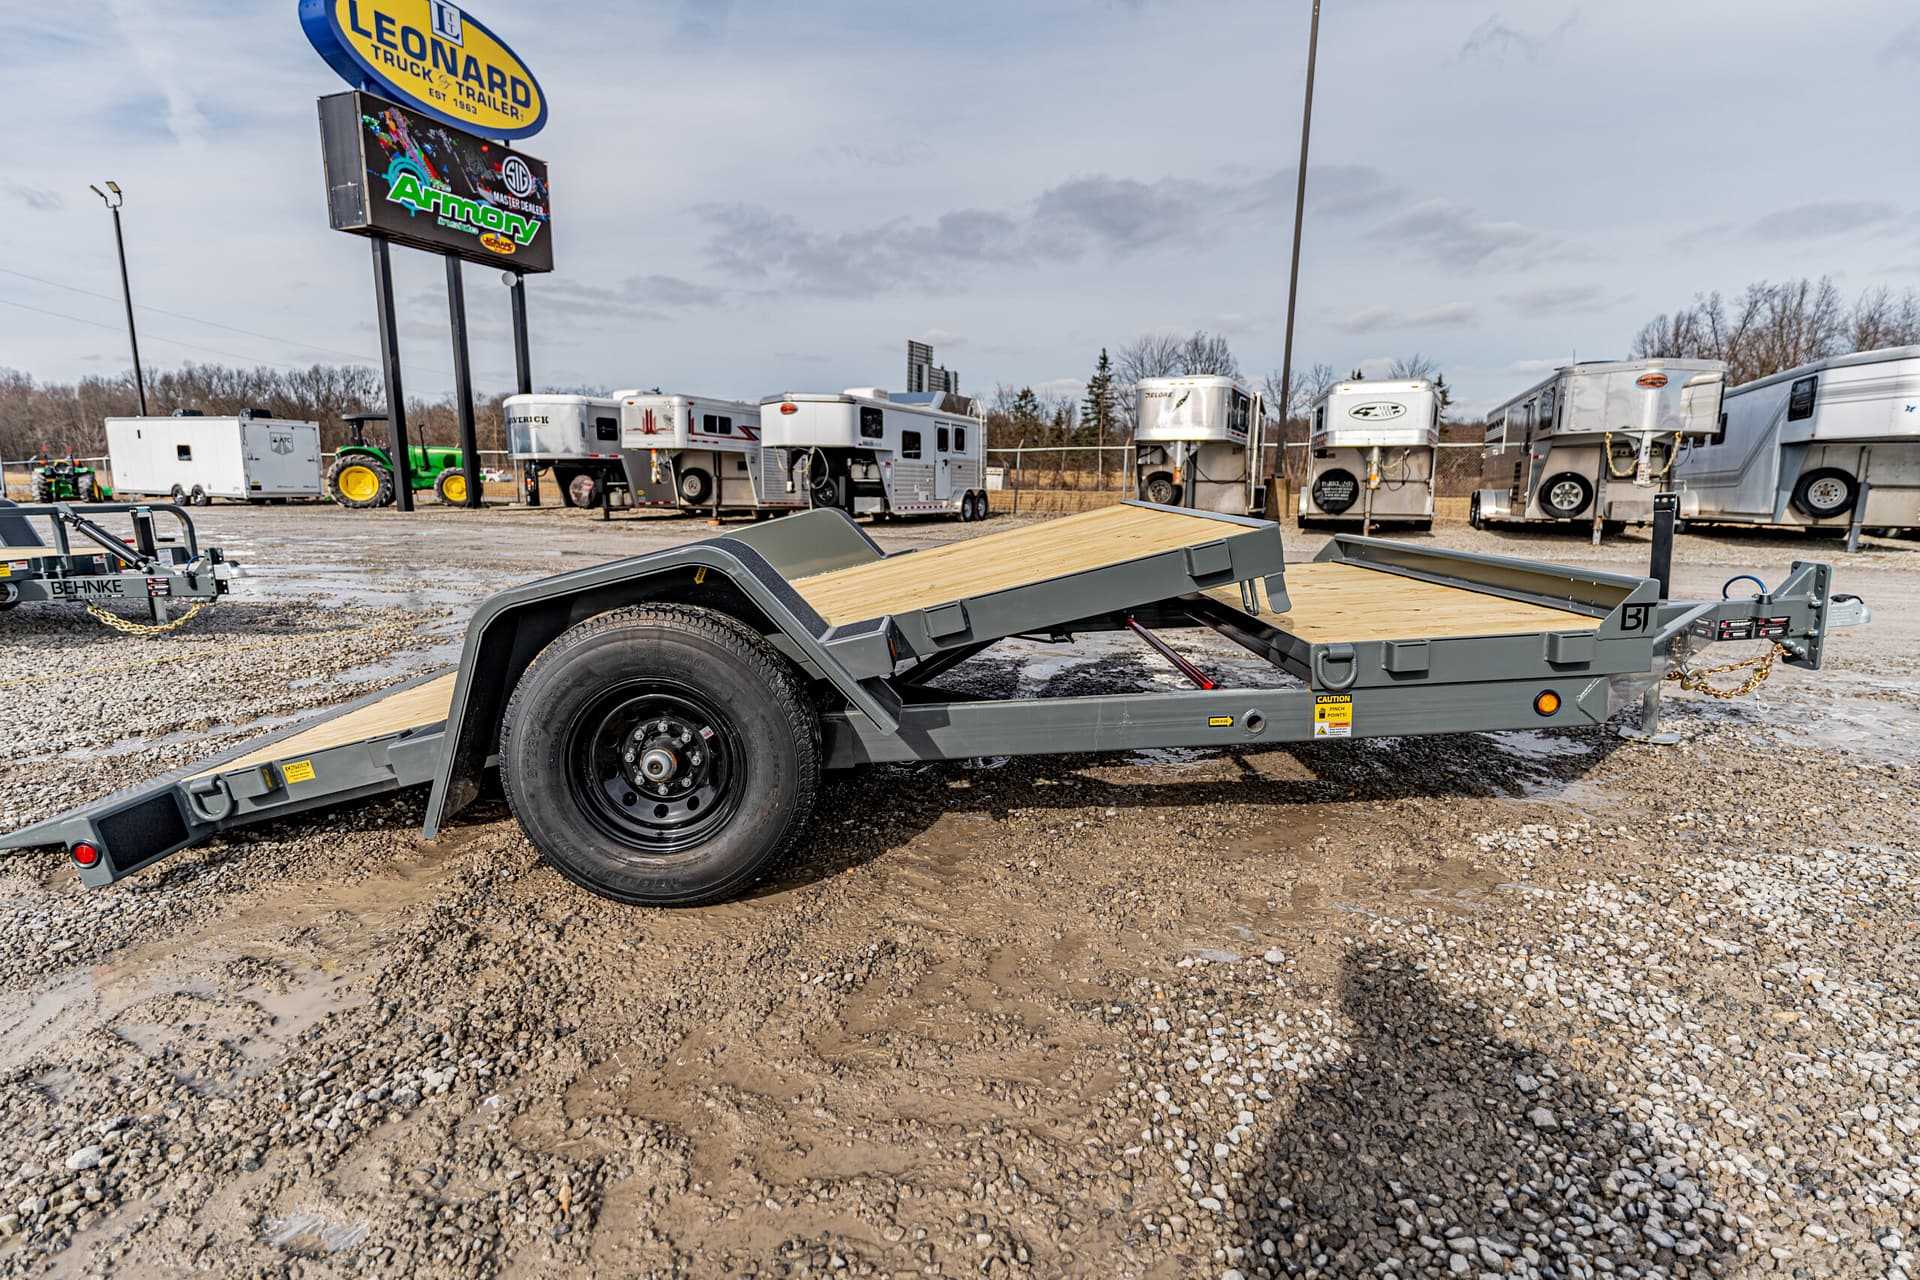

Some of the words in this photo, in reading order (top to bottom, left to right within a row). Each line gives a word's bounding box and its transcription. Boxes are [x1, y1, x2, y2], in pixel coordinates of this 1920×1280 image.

[350, 0, 531, 109] LEONARD
[371, 43, 434, 84] TRUCK
[455, 80, 520, 121] TRAILER
[428, 87, 447, 103] EST
[453, 98, 478, 116] 1963
[504, 158, 531, 193] SIG
[387, 172, 542, 246] Armory
[493, 190, 520, 209] MASTER
[520, 199, 544, 216] DEALER
[51, 579, 124, 595] BEHNKE
[1317, 695, 1351, 703] CAUTION
